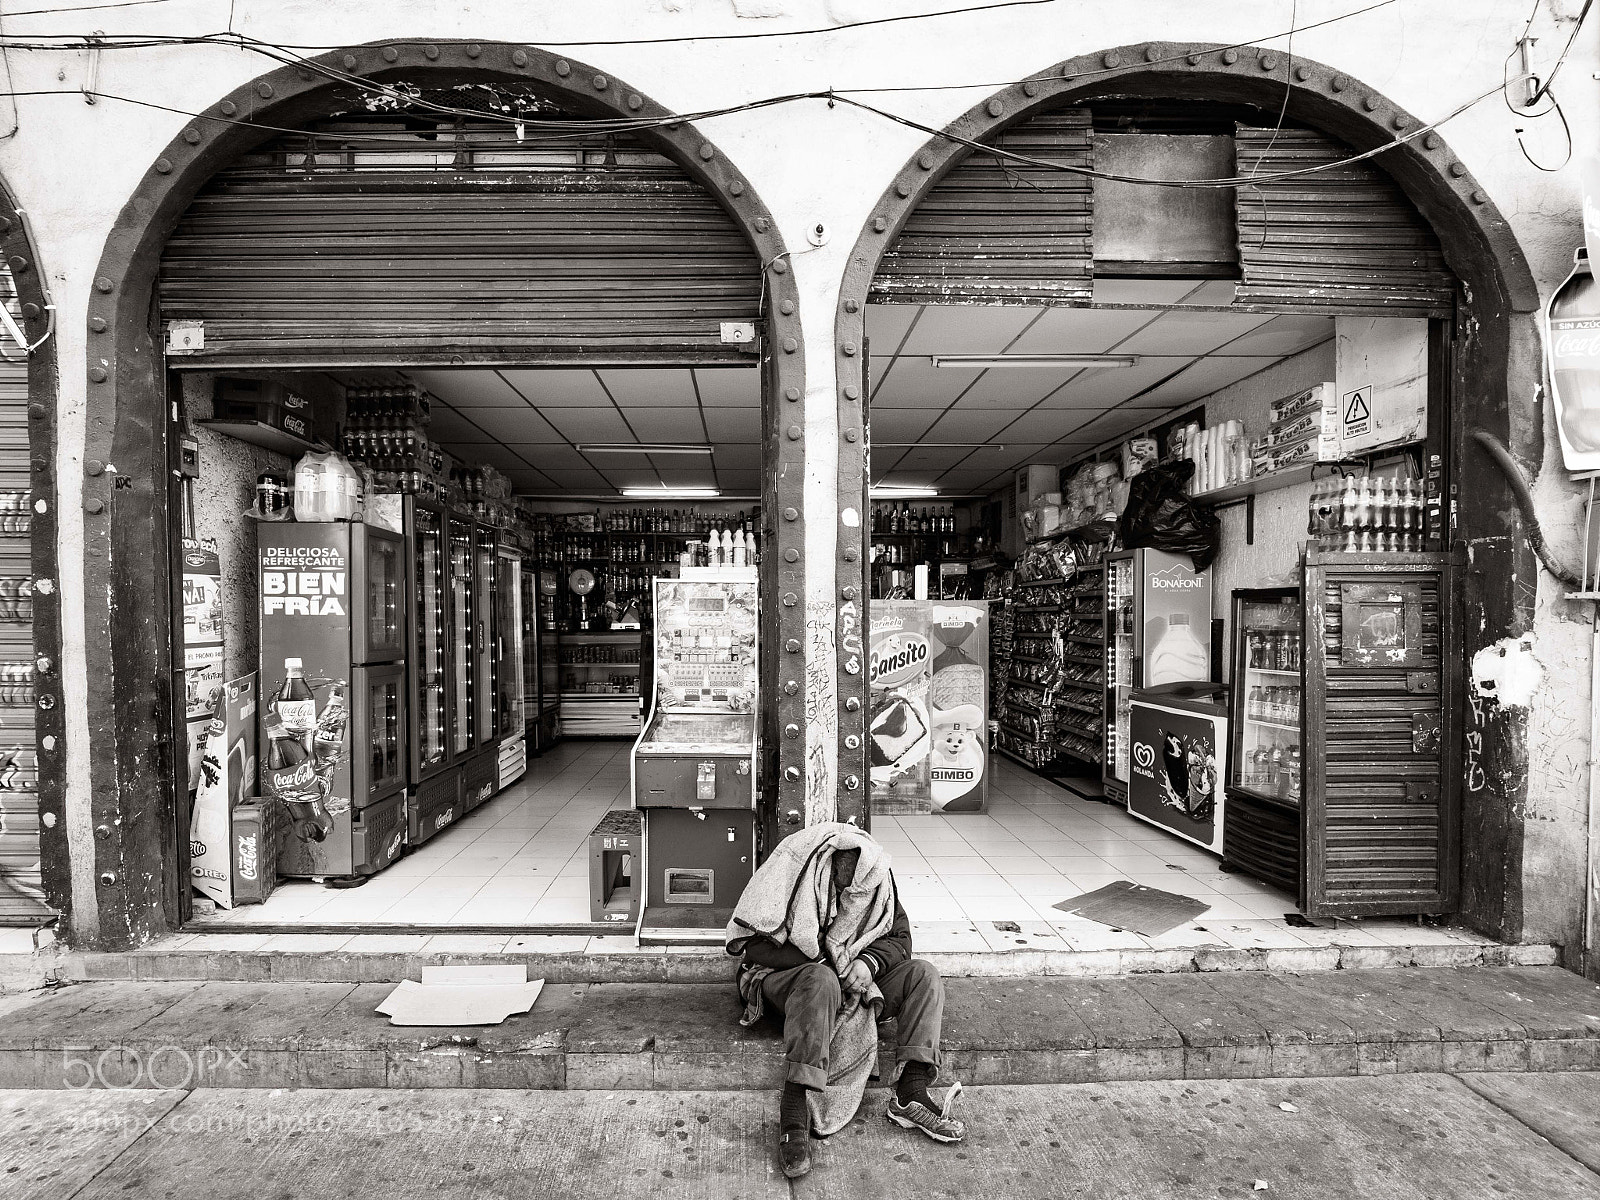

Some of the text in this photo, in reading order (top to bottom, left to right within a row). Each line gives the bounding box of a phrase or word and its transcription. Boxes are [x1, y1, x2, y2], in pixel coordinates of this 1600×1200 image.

[1559, 322, 1575, 330] SIN
[267, 547, 340, 557] DELICIOSA
[263, 557, 345, 566] REFRESCANTE
[263, 572, 346, 595] BIEN
[1152, 577, 1204, 588] BONAFONT
[263, 595, 346, 616] FRÍA
[274, 759, 316, 788] Coca-Cola
[931, 770, 974, 780] BIMBO
[239, 833, 258, 880] Coca-Cola
[192, 866, 227, 881] OREO
